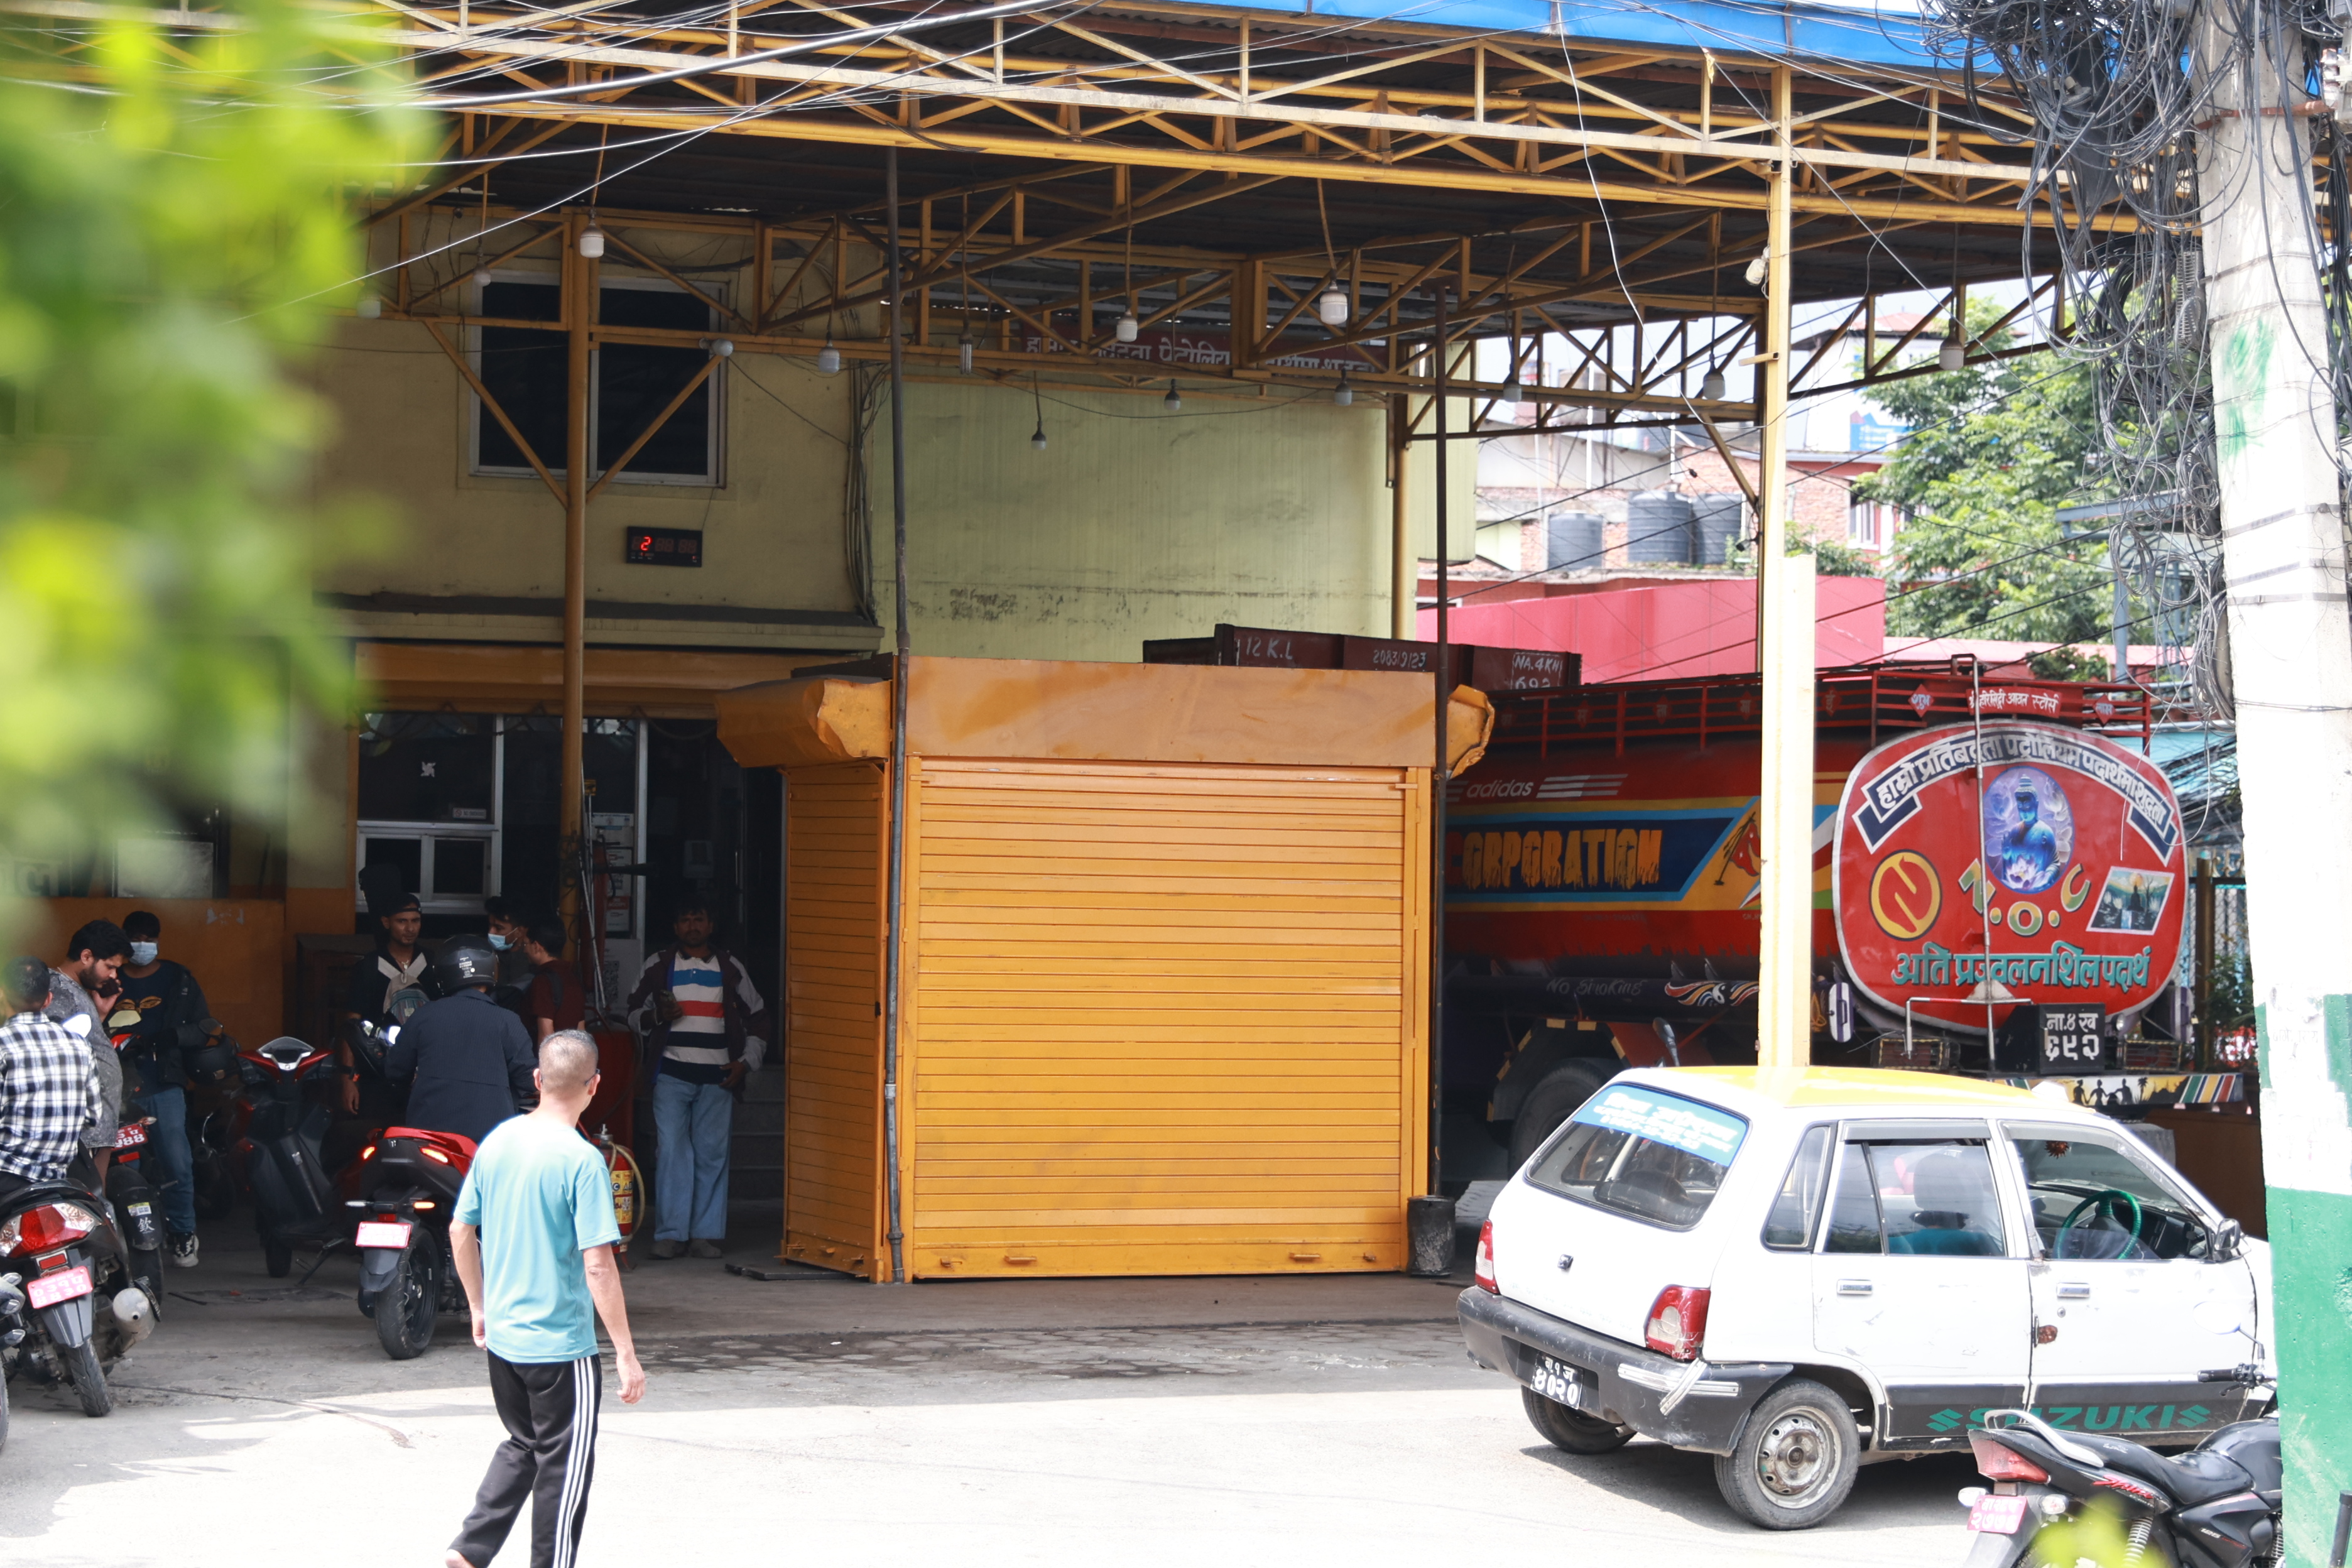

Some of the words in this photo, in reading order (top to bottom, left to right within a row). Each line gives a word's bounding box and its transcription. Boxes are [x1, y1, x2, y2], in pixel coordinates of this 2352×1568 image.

[1246, 636, 1261, 657] 12
[1466, 780, 1534, 798] adidas
[1891, 941, 1952, 986] अति
[1534, 1368, 1578, 1405] ४०२०
[1965, 1404, 2175, 1430] SUZUKI
